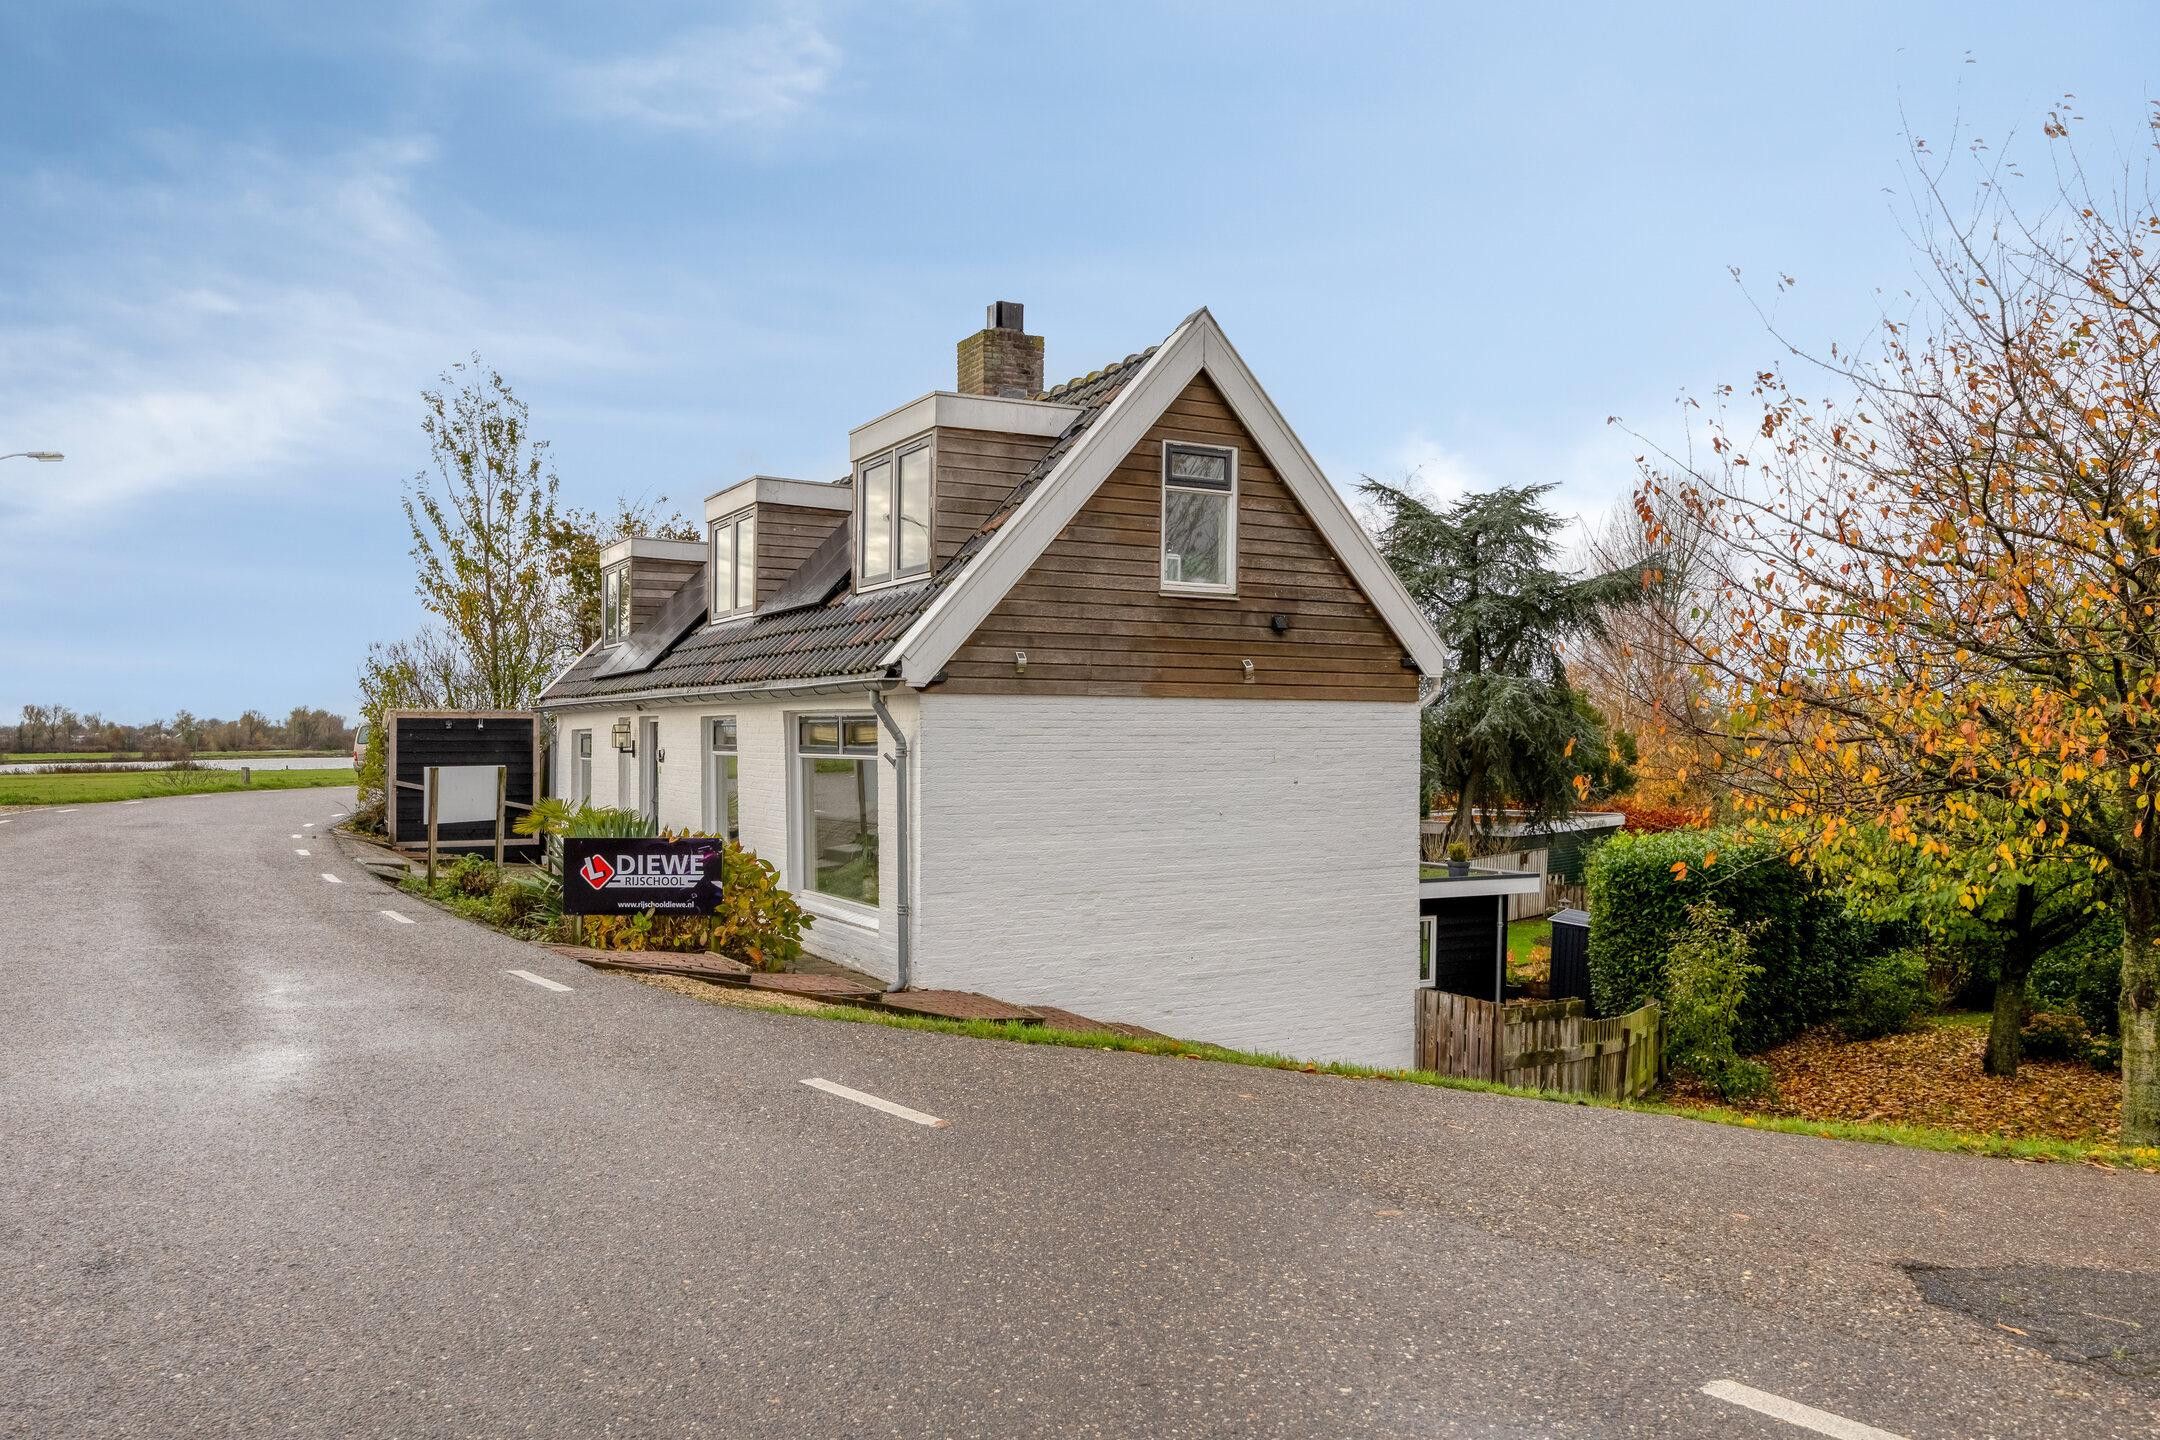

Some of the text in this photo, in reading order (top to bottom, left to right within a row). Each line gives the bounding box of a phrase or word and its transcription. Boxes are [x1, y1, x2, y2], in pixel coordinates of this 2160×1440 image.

[616, 854, 705, 875] DIEWE
[624, 876, 685, 886] RIJSCHOOL
[617, 901, 695, 909] www.rijschooldiewe.nl
